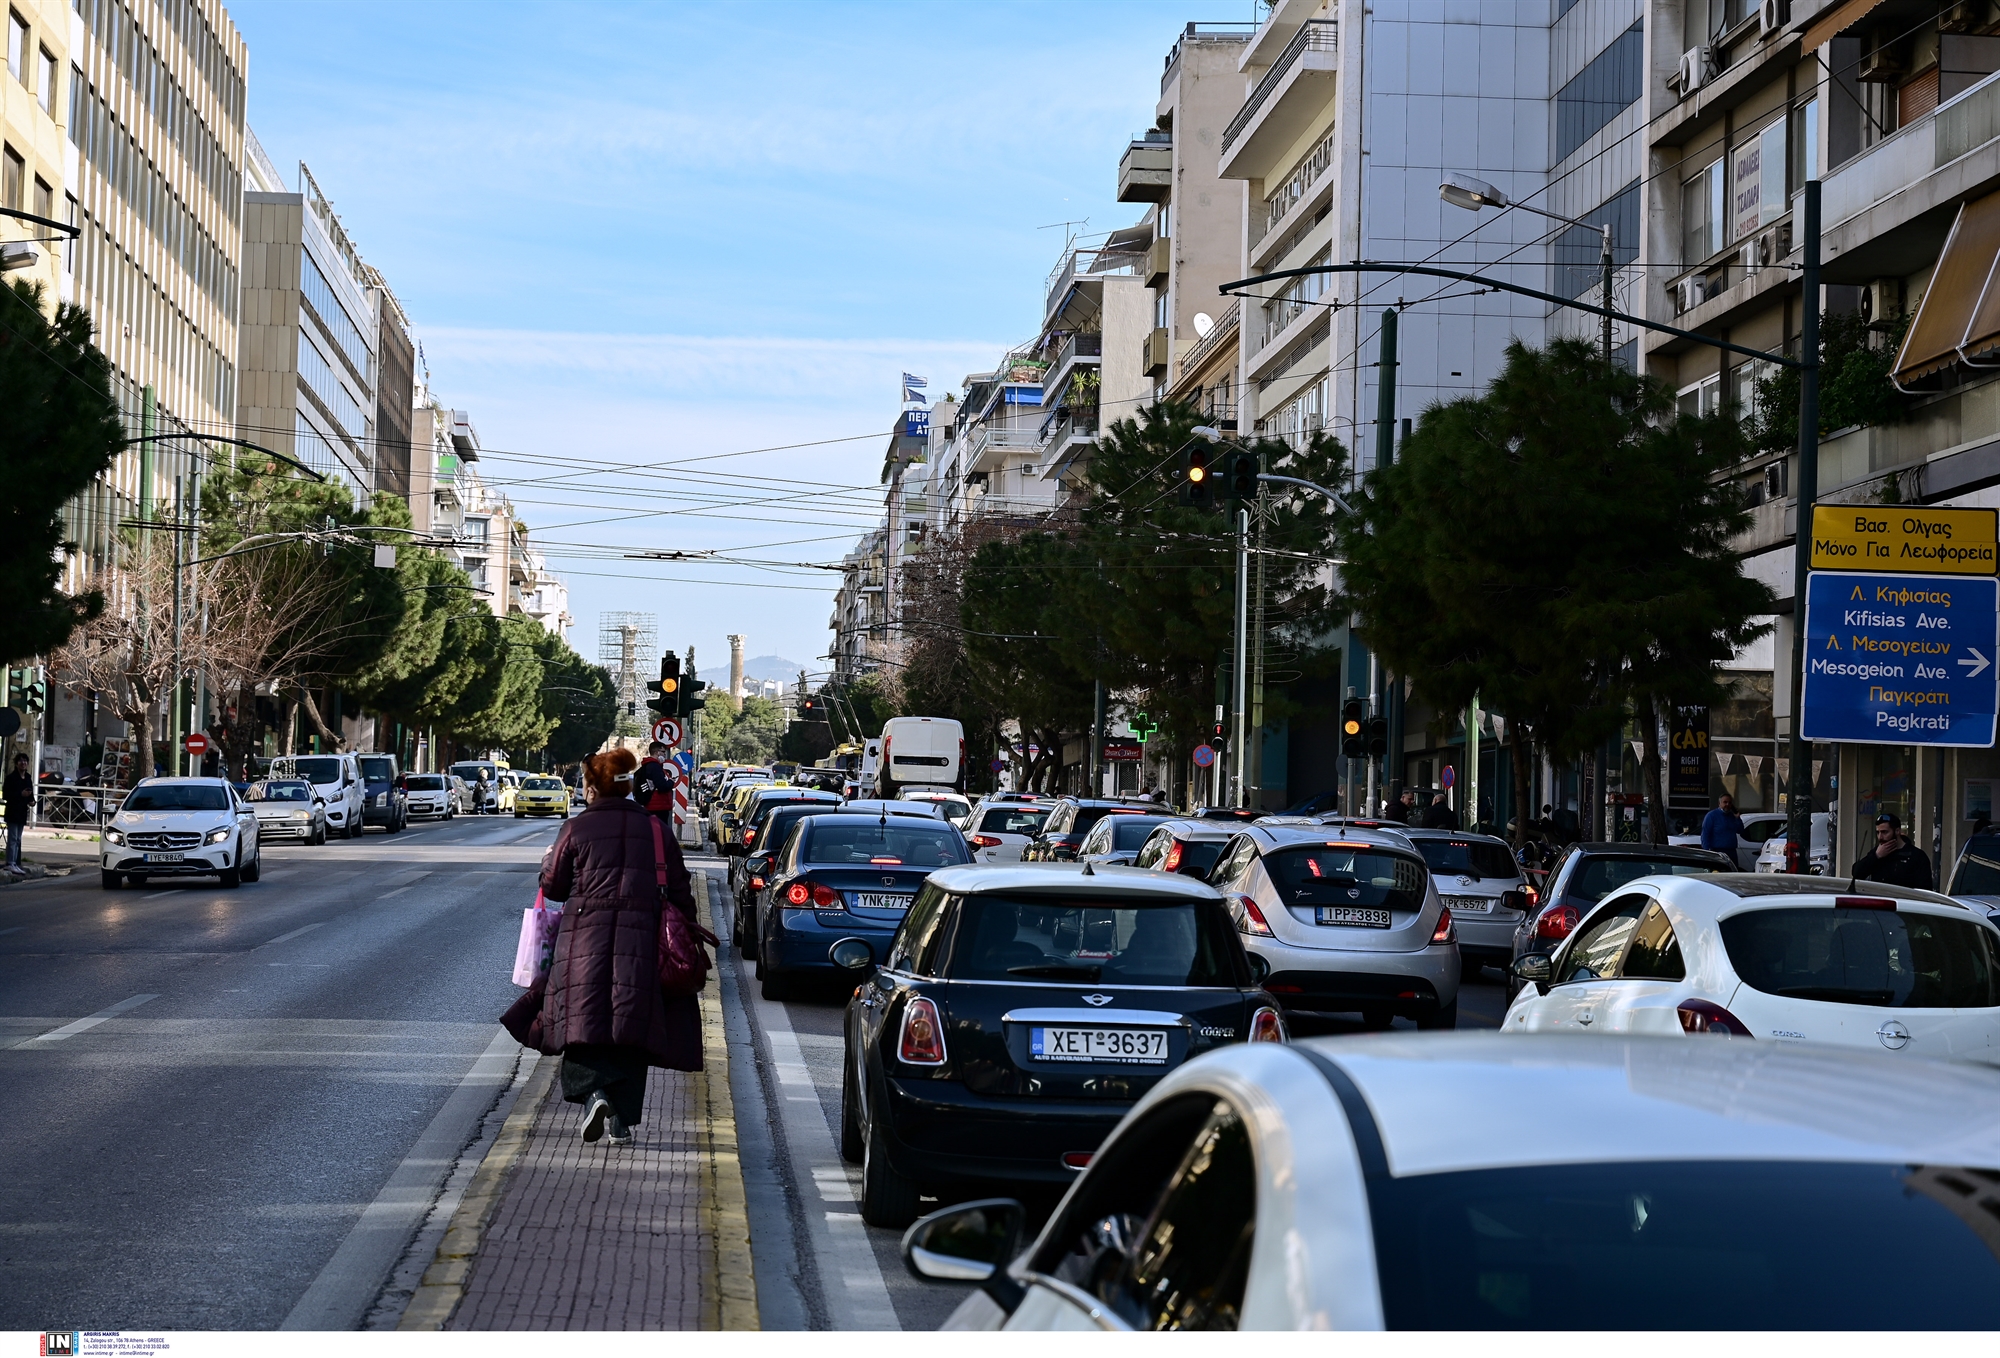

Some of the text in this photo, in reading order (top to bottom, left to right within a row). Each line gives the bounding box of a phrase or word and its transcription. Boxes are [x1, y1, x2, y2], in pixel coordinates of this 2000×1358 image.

[1855, 517, 1952, 539] Βασ. Ολγας
[1815, 540, 1993, 563] Μόνο Για Λεωφορεία
[1850, 585, 1951, 607] Λ. Κηφισίας
[1844, 610, 1951, 629] Kifisias Ave.
[1826, 634, 1951, 657] Λ. Μεσογείων
[1811, 658, 1950, 680] Mesogeion Ave.
[1869, 686, 1950, 707] Παγκράτι
[1687, 718, 1693, 727] A
[1876, 711, 1950, 732] Pagkrati
[1672, 728, 1708, 750] CAR
[1681, 756, 1699, 765] RIGHT
[1681, 766, 1699, 774] HERE!
[1200, 1026, 1235, 1037] COOPER
